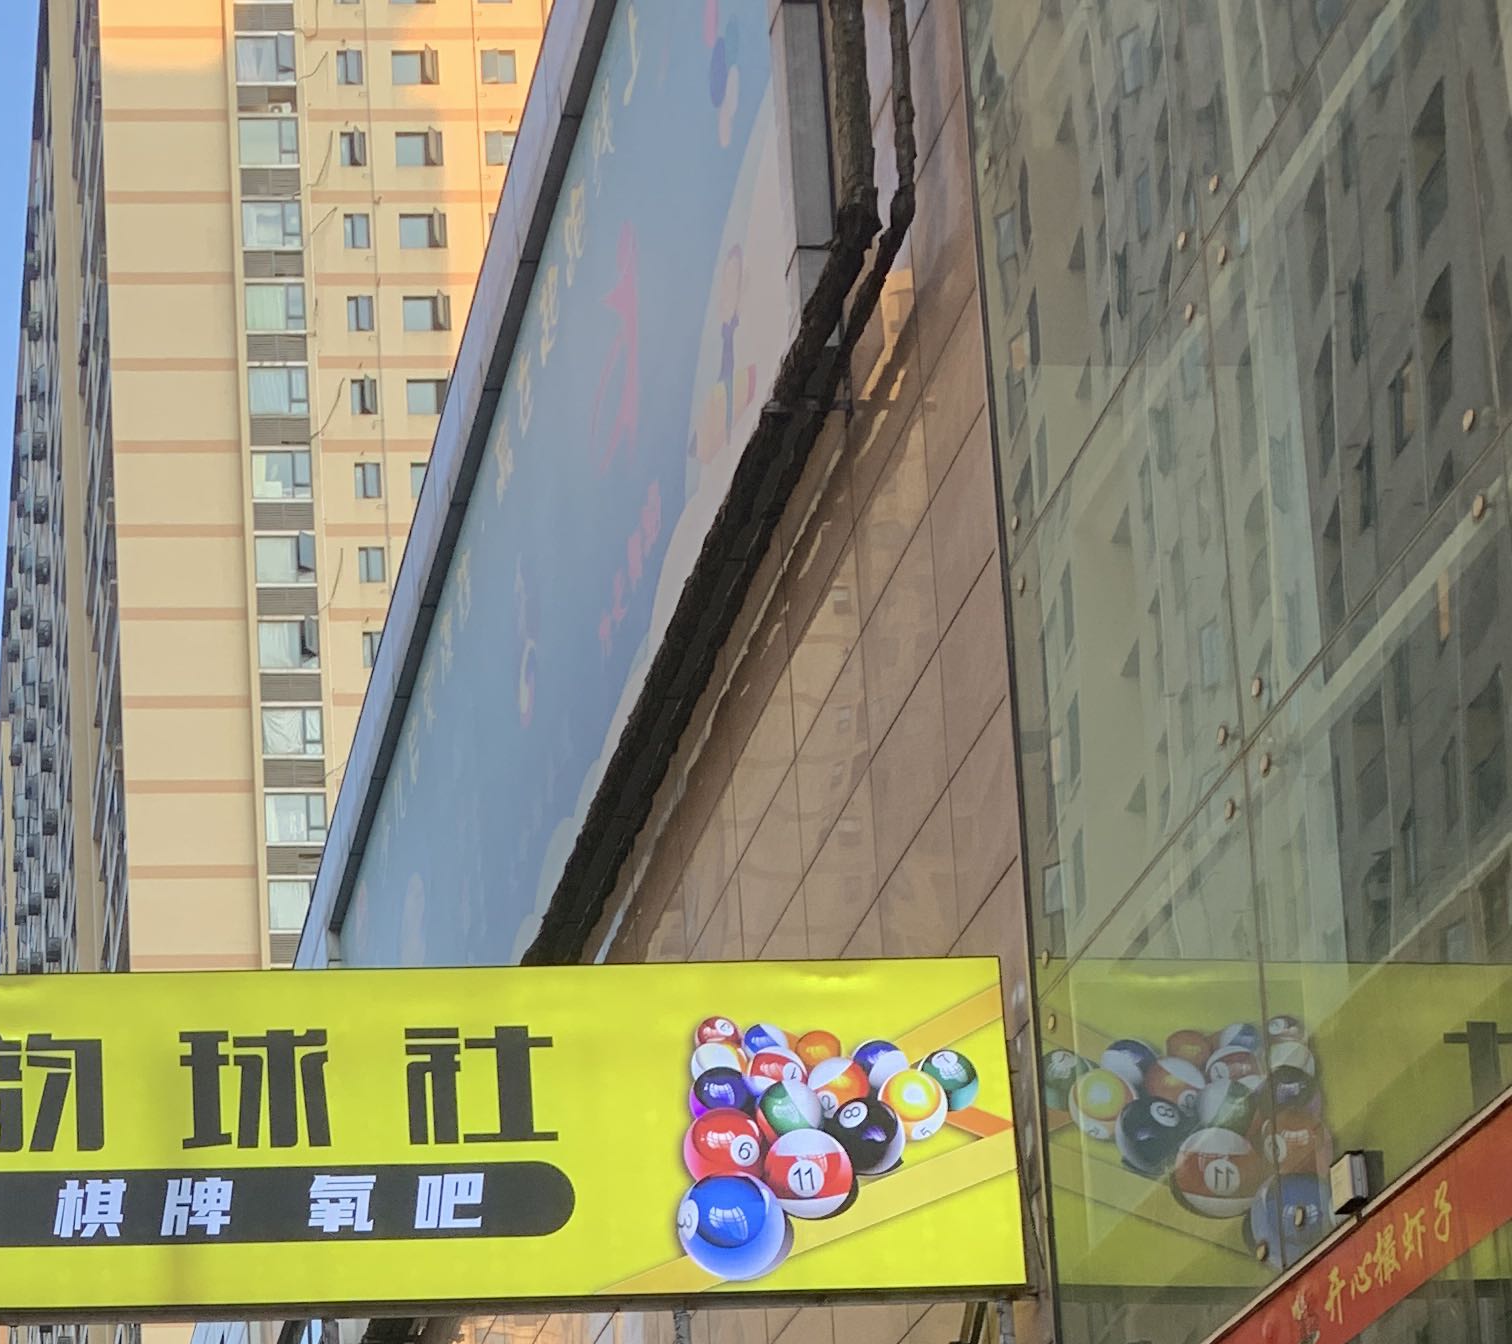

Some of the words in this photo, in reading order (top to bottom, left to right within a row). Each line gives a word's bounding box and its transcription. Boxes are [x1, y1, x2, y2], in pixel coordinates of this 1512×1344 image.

[843, 1106, 862, 1120] 8
[792, 1168, 815, 1192] 11
[53, 1177, 235, 1238] 棋牌
[308, 1173, 486, 1233] 氧吧
